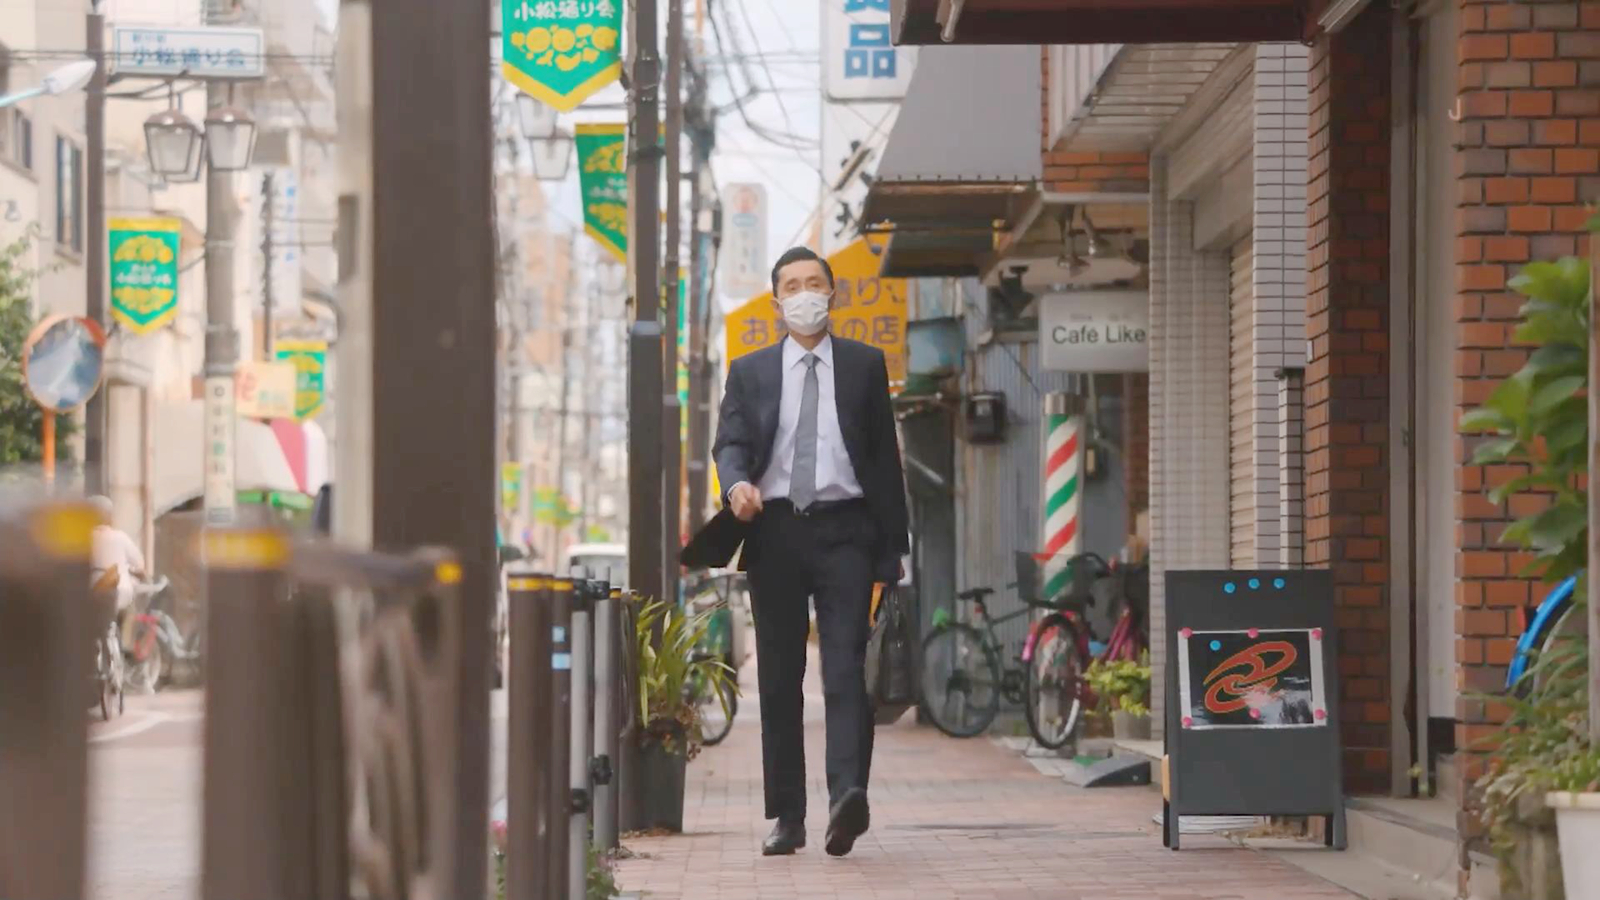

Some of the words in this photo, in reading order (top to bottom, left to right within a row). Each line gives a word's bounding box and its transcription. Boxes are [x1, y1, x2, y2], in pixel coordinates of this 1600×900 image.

[514, 0, 615, 21] 小松通り会
[843, 0, 896, 78] 品
[1052, 325, 1099, 344] Café
[1106, 325, 1146, 343] Like
